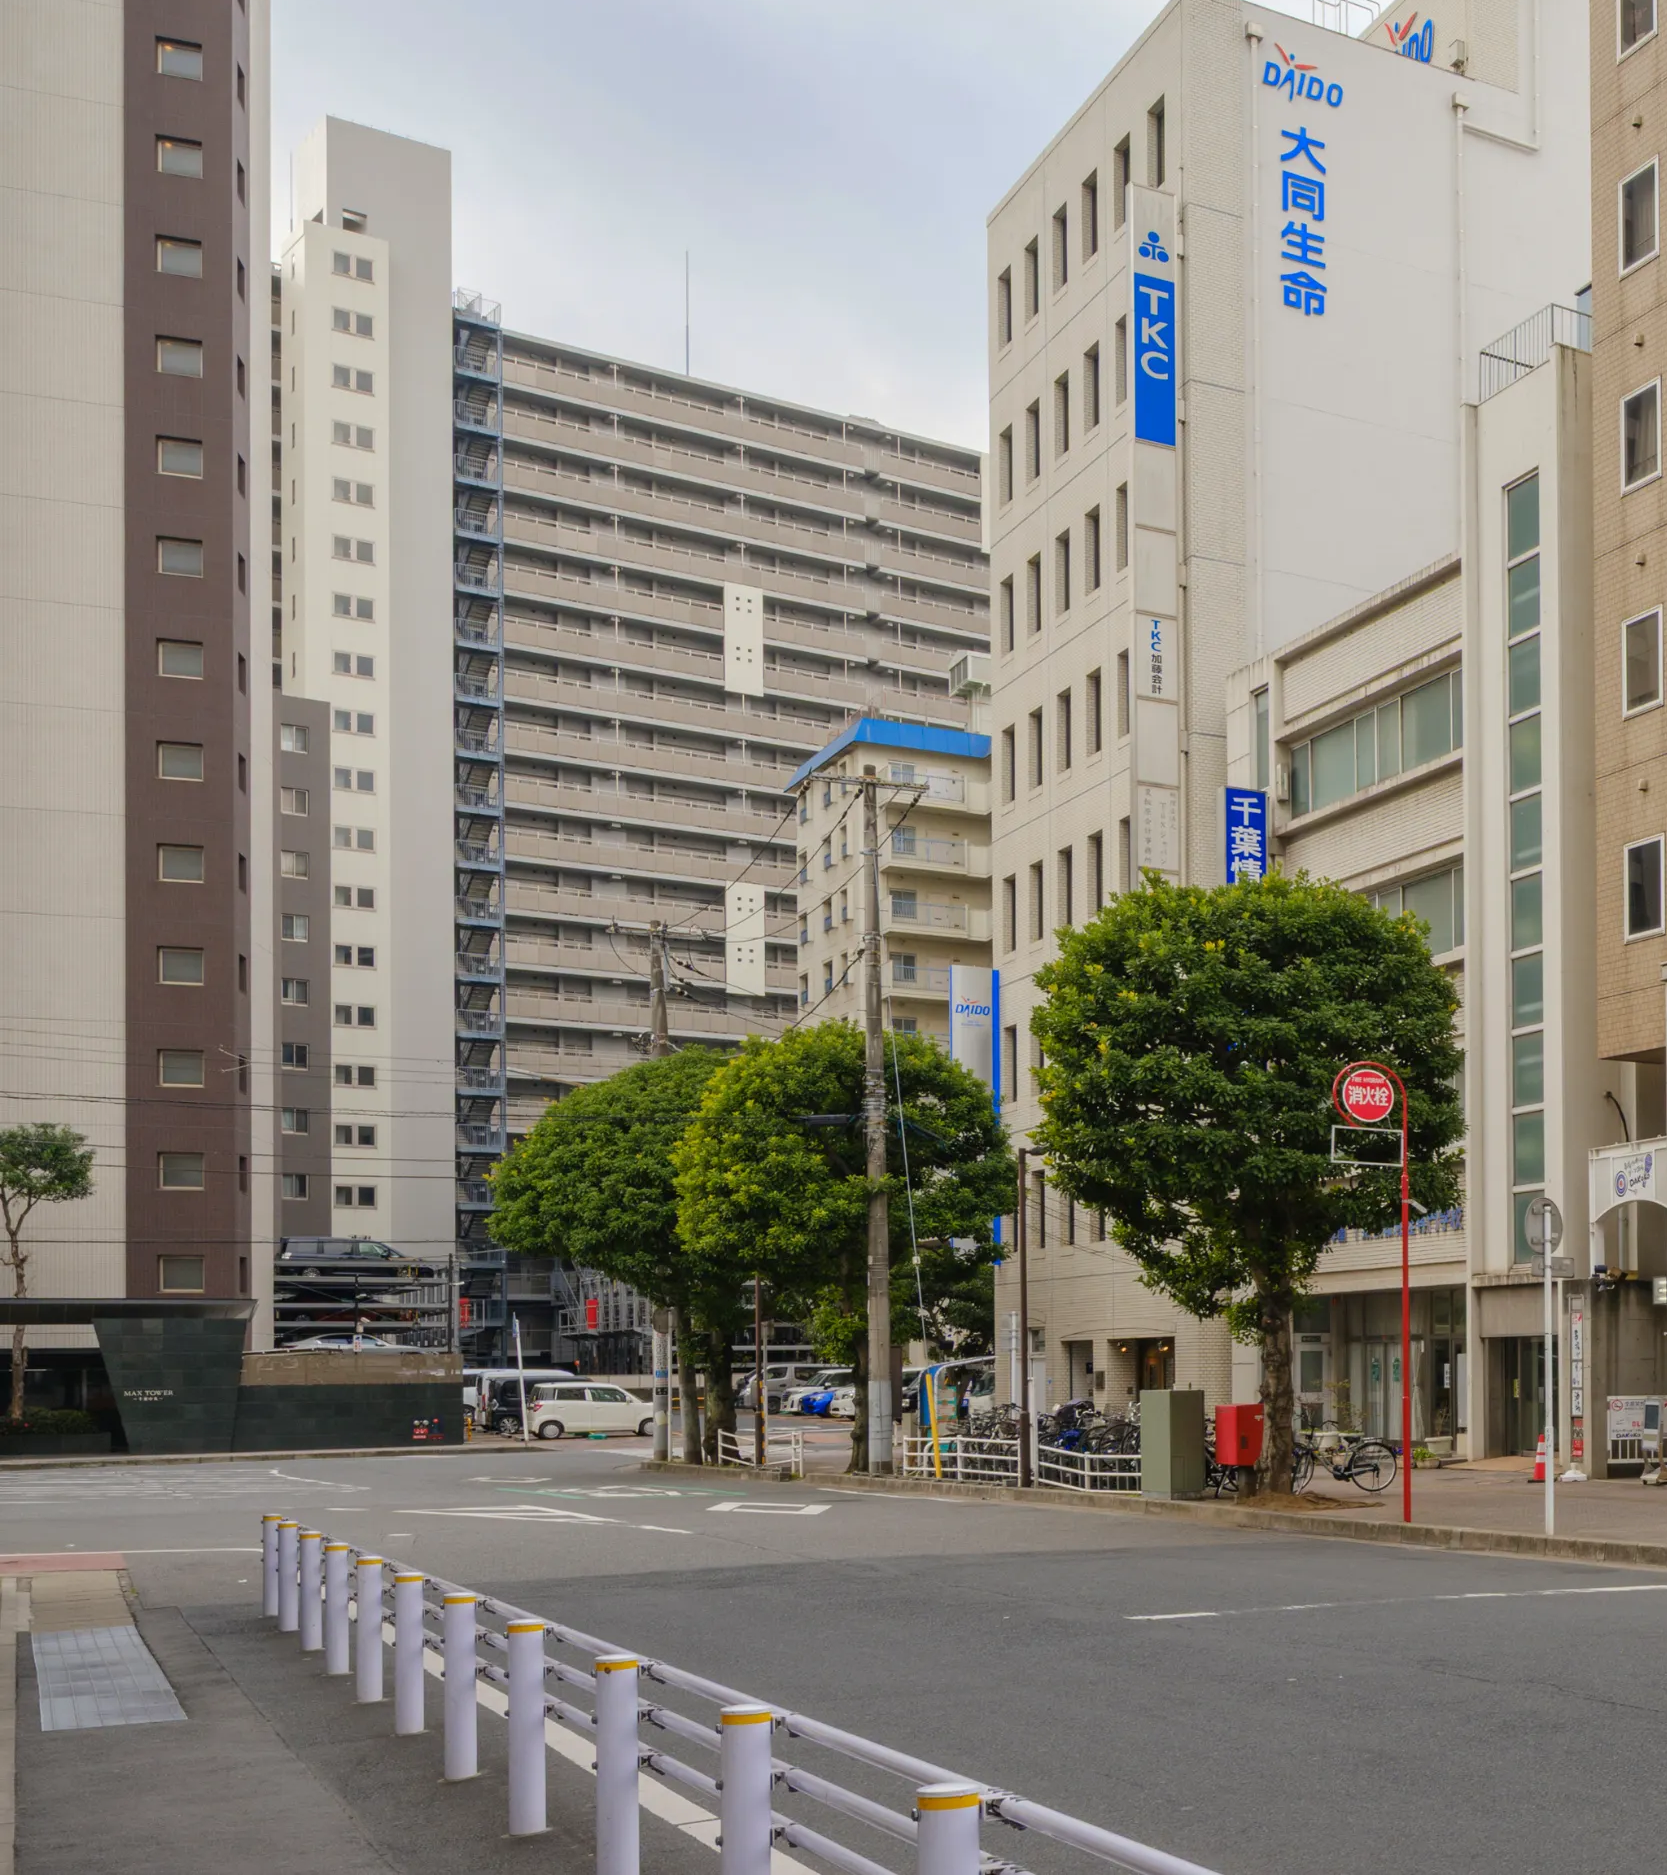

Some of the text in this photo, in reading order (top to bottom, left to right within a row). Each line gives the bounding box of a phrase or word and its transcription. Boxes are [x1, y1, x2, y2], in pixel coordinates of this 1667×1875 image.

[1262, 60, 1343, 107] DAIDO
[1280, 126, 1327, 315] 大同生命
[1139, 285, 1169, 380] TKC
[1150, 619, 1161, 653] TKC
[955, 1003, 990, 1017] DAIDO
[1348, 1086, 1389, 1106] 消火栓
